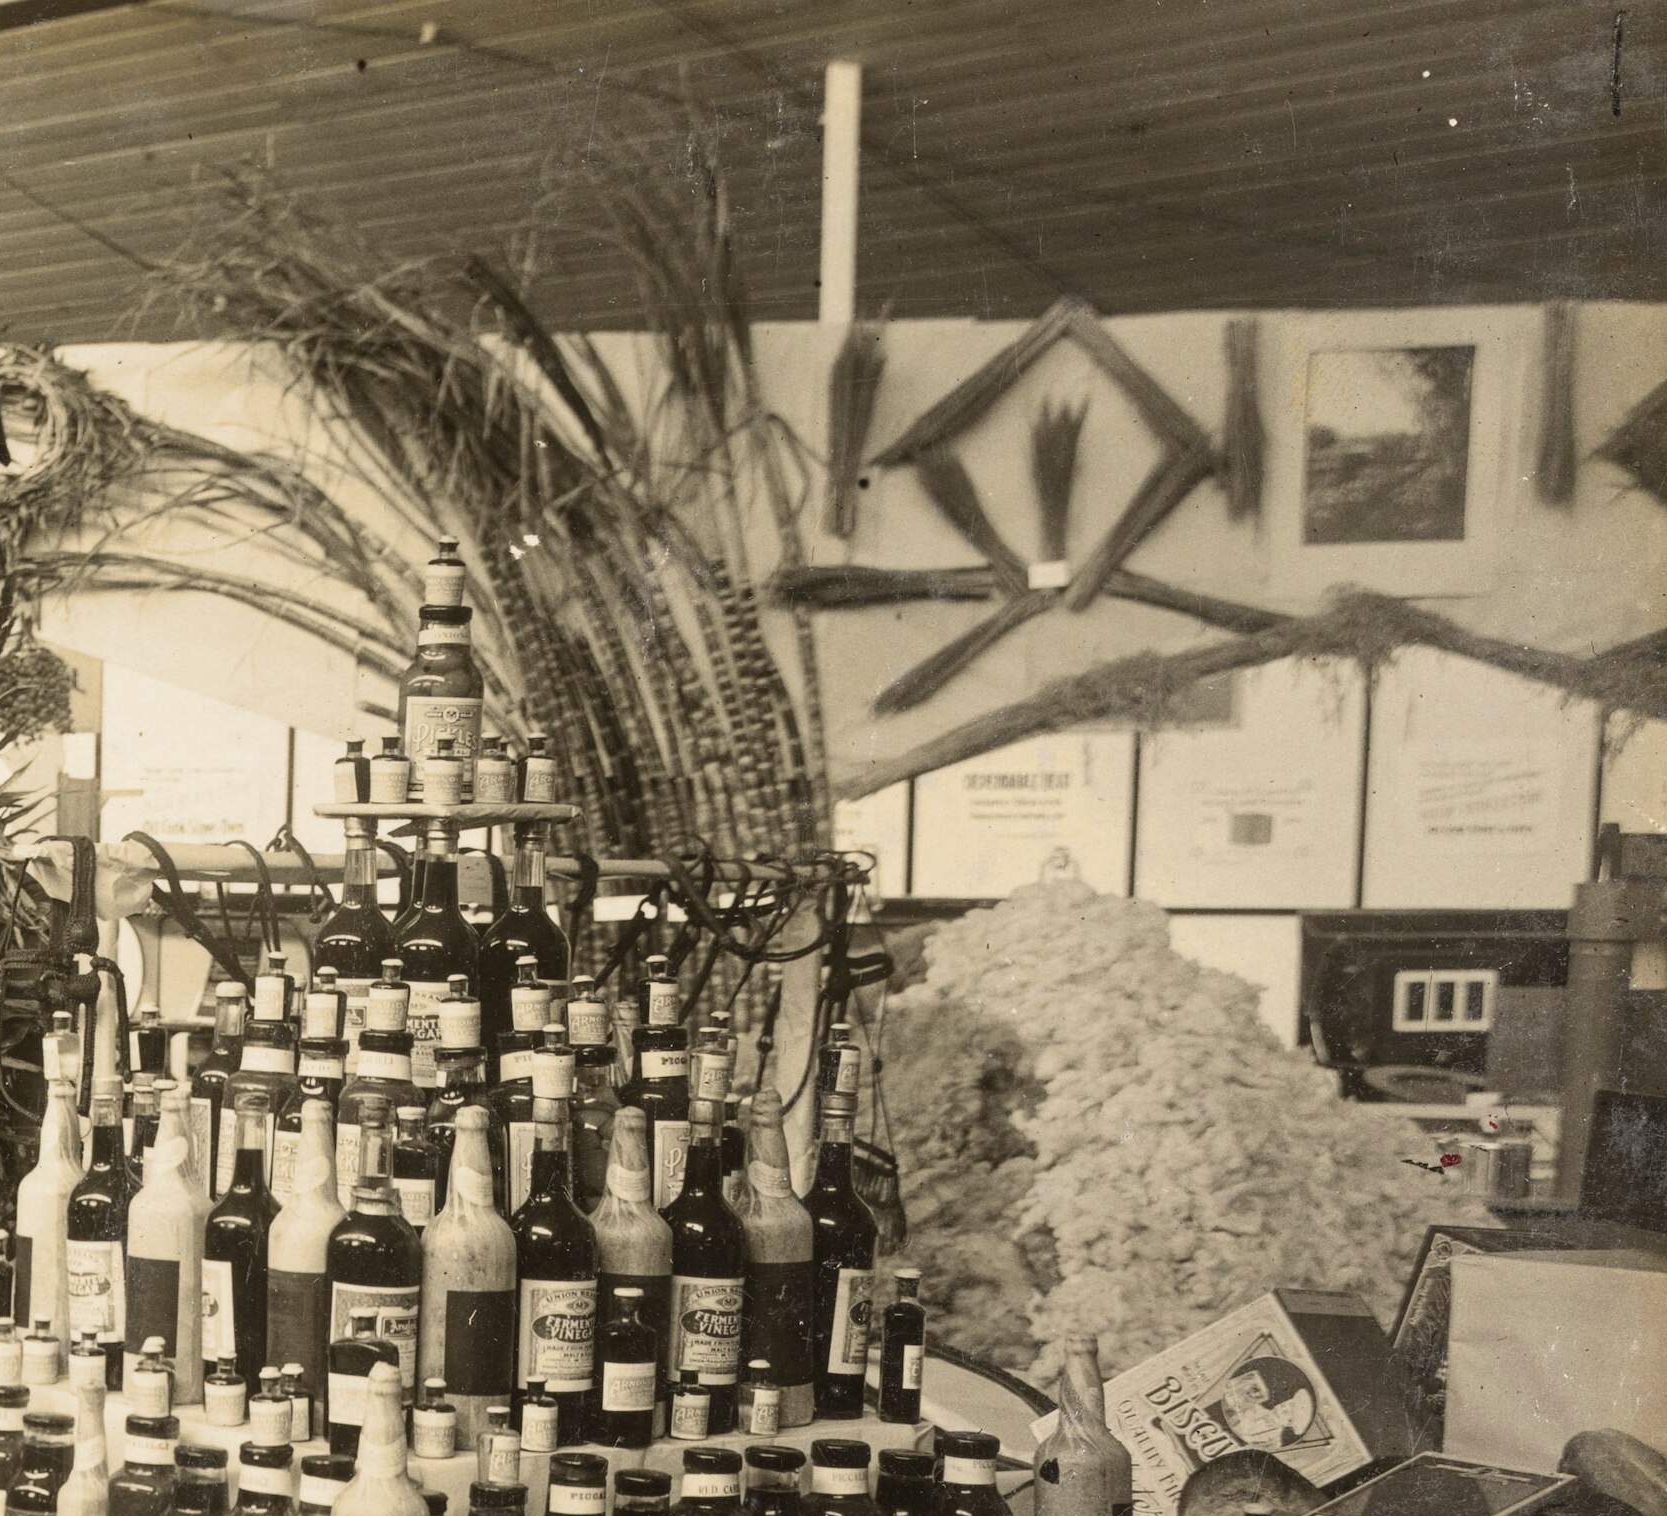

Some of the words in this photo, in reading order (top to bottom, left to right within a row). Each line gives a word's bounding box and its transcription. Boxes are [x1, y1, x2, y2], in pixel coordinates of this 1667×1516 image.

[546, 1291, 577, 1302] UNION
[696, 1288, 730, 1298] UNION
[1117, 1399, 1166, 1468] QUALITY
